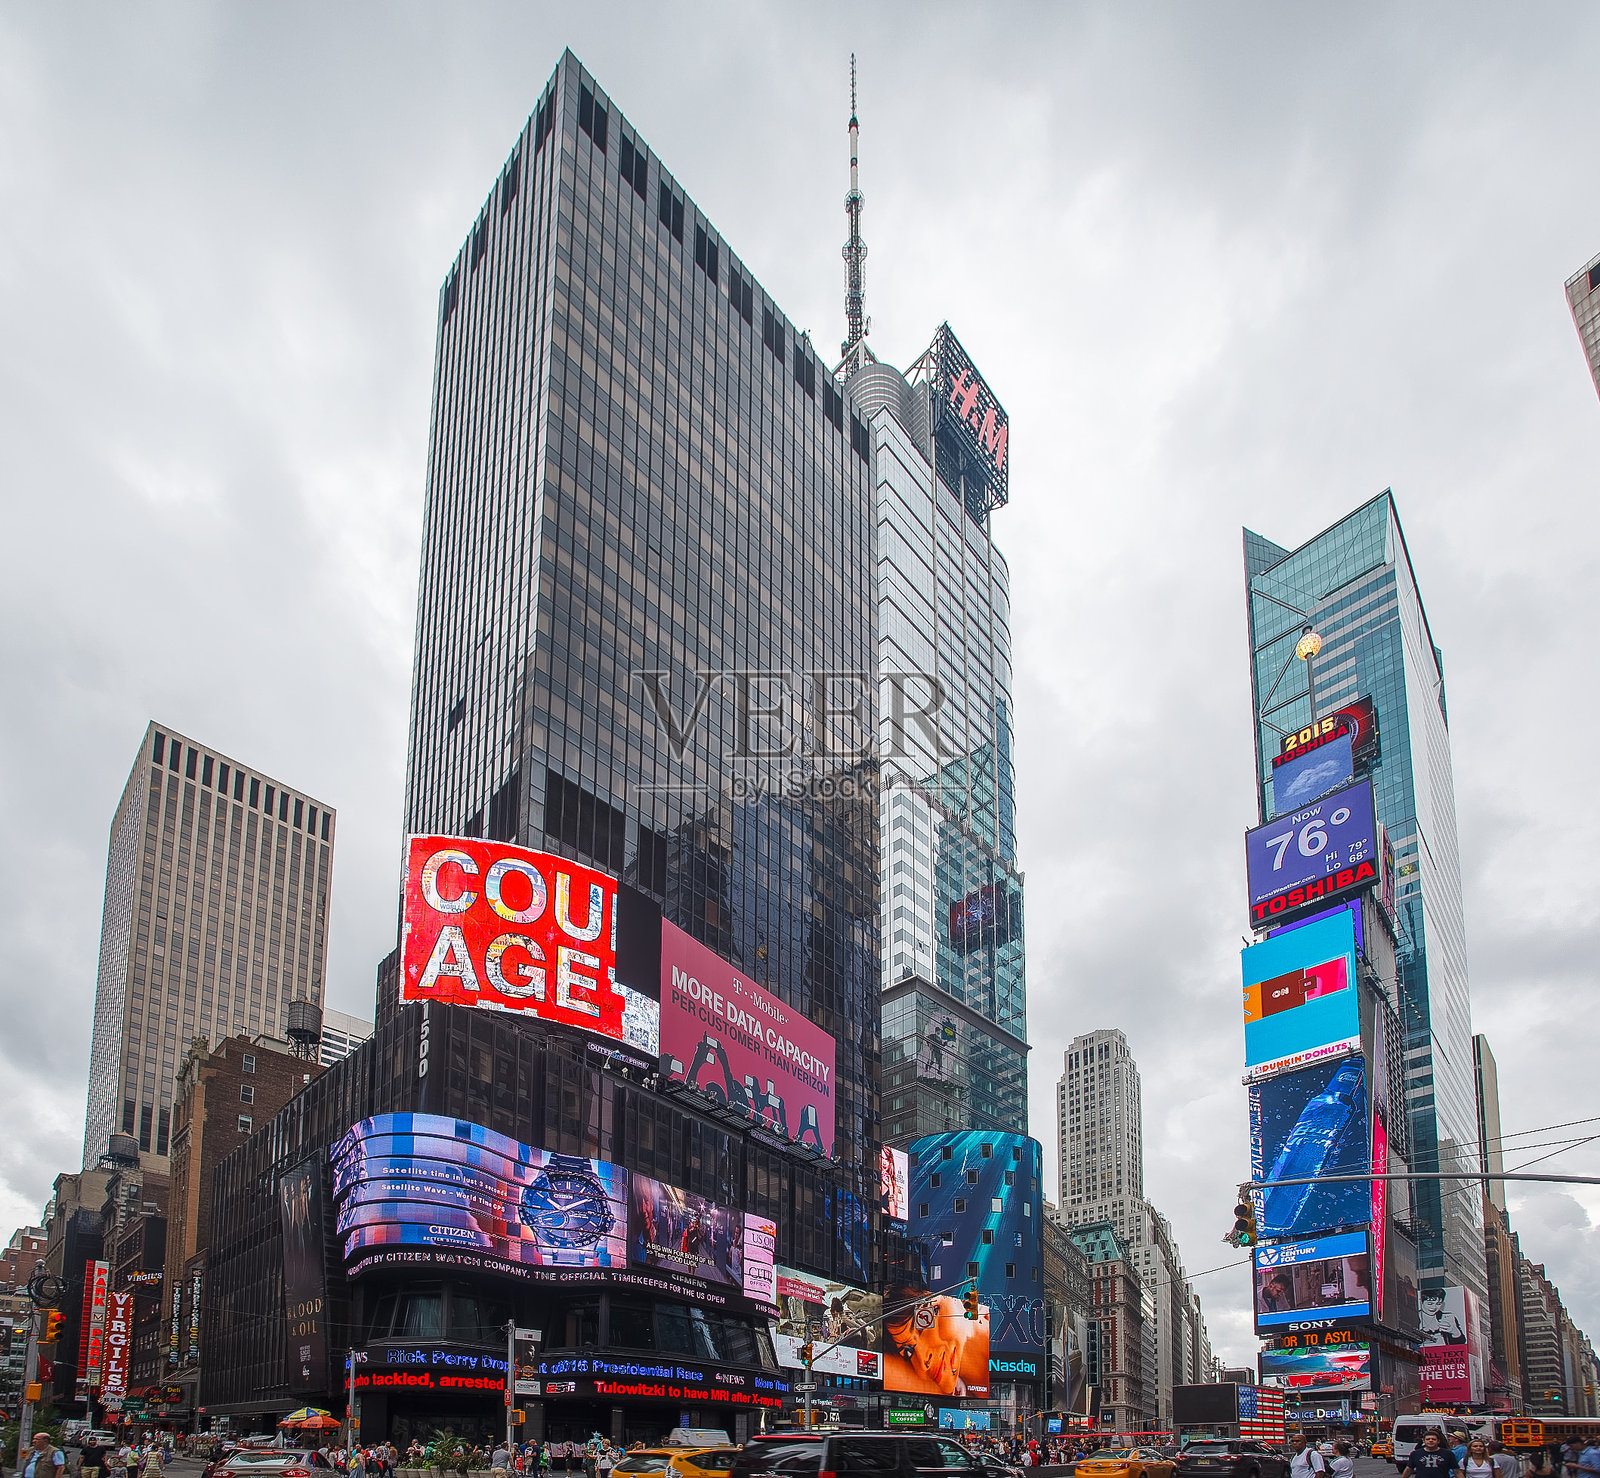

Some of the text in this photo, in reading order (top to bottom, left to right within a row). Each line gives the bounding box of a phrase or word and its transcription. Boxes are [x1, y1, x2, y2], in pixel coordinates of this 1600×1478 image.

[949, 368, 1009, 472] H&M
[1285, 715, 1335, 752] 2015
[1273, 725, 1349, 768] TOSHIBA
[1291, 805, 1322, 826] Now
[1324, 850, 1338, 862] Hi
[1326, 861, 1342, 873] Lo
[1251, 861, 1375, 920] TOSHIBA
[1256, 873, 1316, 901] AccuWeather.com
[1299, 895, 1325, 908] TOSHIBA
[417, 925, 602, 1018] AGE
[1272, 986, 1290, 999] ON
[671, 964, 831, 1083] MORE DATA CAPACITY
[671, 989, 830, 1098] PER CUSTOMER THAN VERIZON
[1261, 1042, 1348, 1073] DUNKIN' DONUTS
[1249, 1087, 1264, 1179] DISTINCTIVE
[382, 1167, 428, 1176] Satellite
[430, 1170, 450, 1179] time
[462, 1176, 478, 1186] just
[484, 1184, 508, 1197] seconds
[382, 1184, 420, 1192] Satellite
[424, 1186, 446, 1195] Wave
[456, 1192, 477, 1202] World
[478, 1197, 493, 1208] Time
[493, 1204, 506, 1212] GPS
[752, 1234, 762, 1245] US
[662, 1246, 672, 1254] WIN
[672, 1249, 684, 1257] FOR
[684, 1252, 698, 1262] BOTH
[667, 1254, 682, 1264] GOOD
[1280, 1246, 1316, 1258] CENTURY
[94, 1268, 108, 1307] PARK
[127, 1272, 163, 1282] VIRGIL'S
[374, 1254, 384, 1264] BY
[386, 1252, 431, 1262] CITIZEN
[436, 1252, 481, 1267] WATCH
[534, 1270, 557, 1280] THE
[560, 1271, 608, 1282] OFFICIAL
[612, 1272, 668, 1290] TIMEKEEPER
[670, 1283, 682, 1294] FOR
[682, 1286, 695, 1298] THE
[696, 1292, 705, 1300] US
[706, 1294, 726, 1304] OPEN
[755, 1302, 767, 1314] THIS
[672, 1273, 708, 1289] SIEMENS
[288, 1298, 322, 1320] BLOOD
[300, 1320, 317, 1336] OIL
[1288, 1319, 1337, 1331] SONY
[88, 1328, 102, 1368] PARK
[108, 1294, 130, 1386] VIRGILS
[1282, 1336, 1298, 1348] OR
[1304, 1334, 1318, 1346] TO
[386, 1349, 428, 1364] Rick
[432, 1350, 478, 1370] Perry
[592, 1360, 674, 1378] Presidential
[676, 1366, 704, 1382] Race
[988, 1359, 1036, 1376] Nasdaq
[1418, 1370, 1468, 1380] THE U.S.
[372, 1372, 436, 1388] tackled,
[439, 1378, 504, 1390] arrested
[722, 1372, 745, 1386] NEWS
[754, 1376, 774, 1390] More
[594, 1380, 666, 1396] Tulowitzki
[668, 1386, 682, 1398] to
[684, 1386, 709, 1400] have
[710, 1389, 730, 1402] MRI
[731, 1392, 752, 1404] after
[752, 1394, 774, 1407] X-rays
[1284, 1410, 1314, 1420] POLICE
